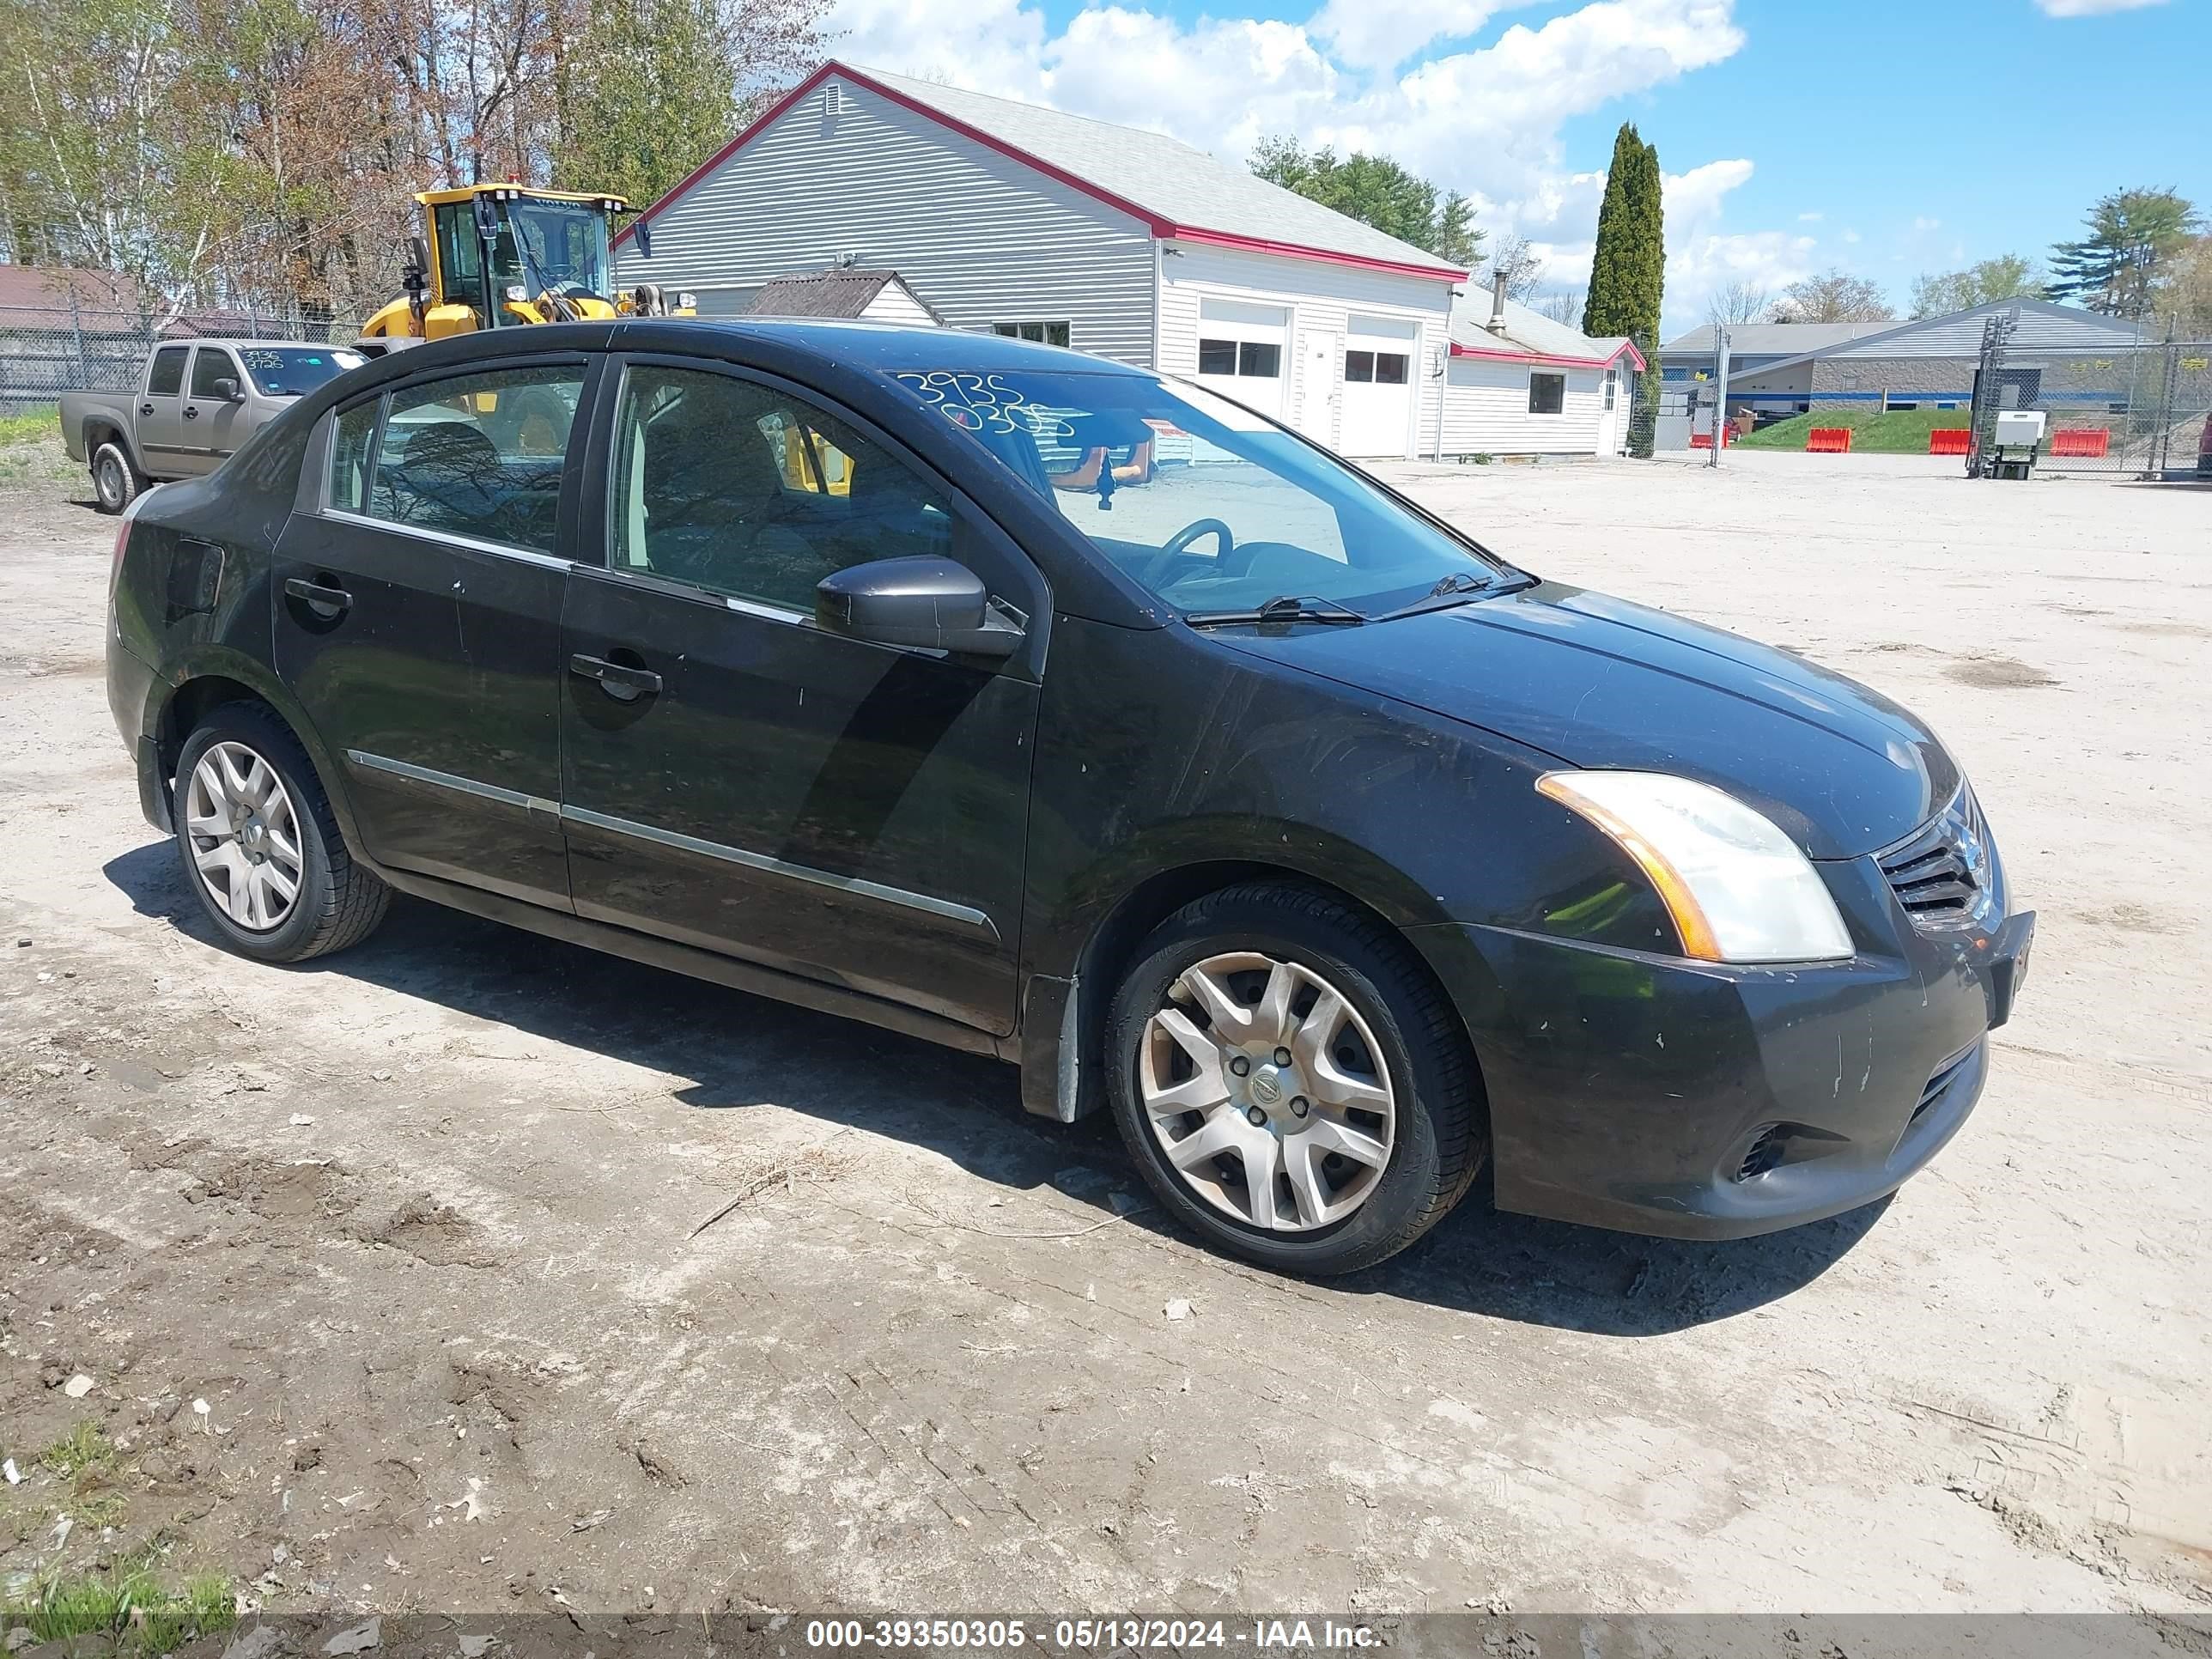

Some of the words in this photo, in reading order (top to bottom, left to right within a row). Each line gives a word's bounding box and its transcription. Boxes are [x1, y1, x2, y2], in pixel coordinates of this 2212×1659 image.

[242, 350, 280, 361] 3936
[246, 359, 284, 370] 3726
[896, 372, 1024, 405] 3935
[940, 403, 1075, 436] 0305
